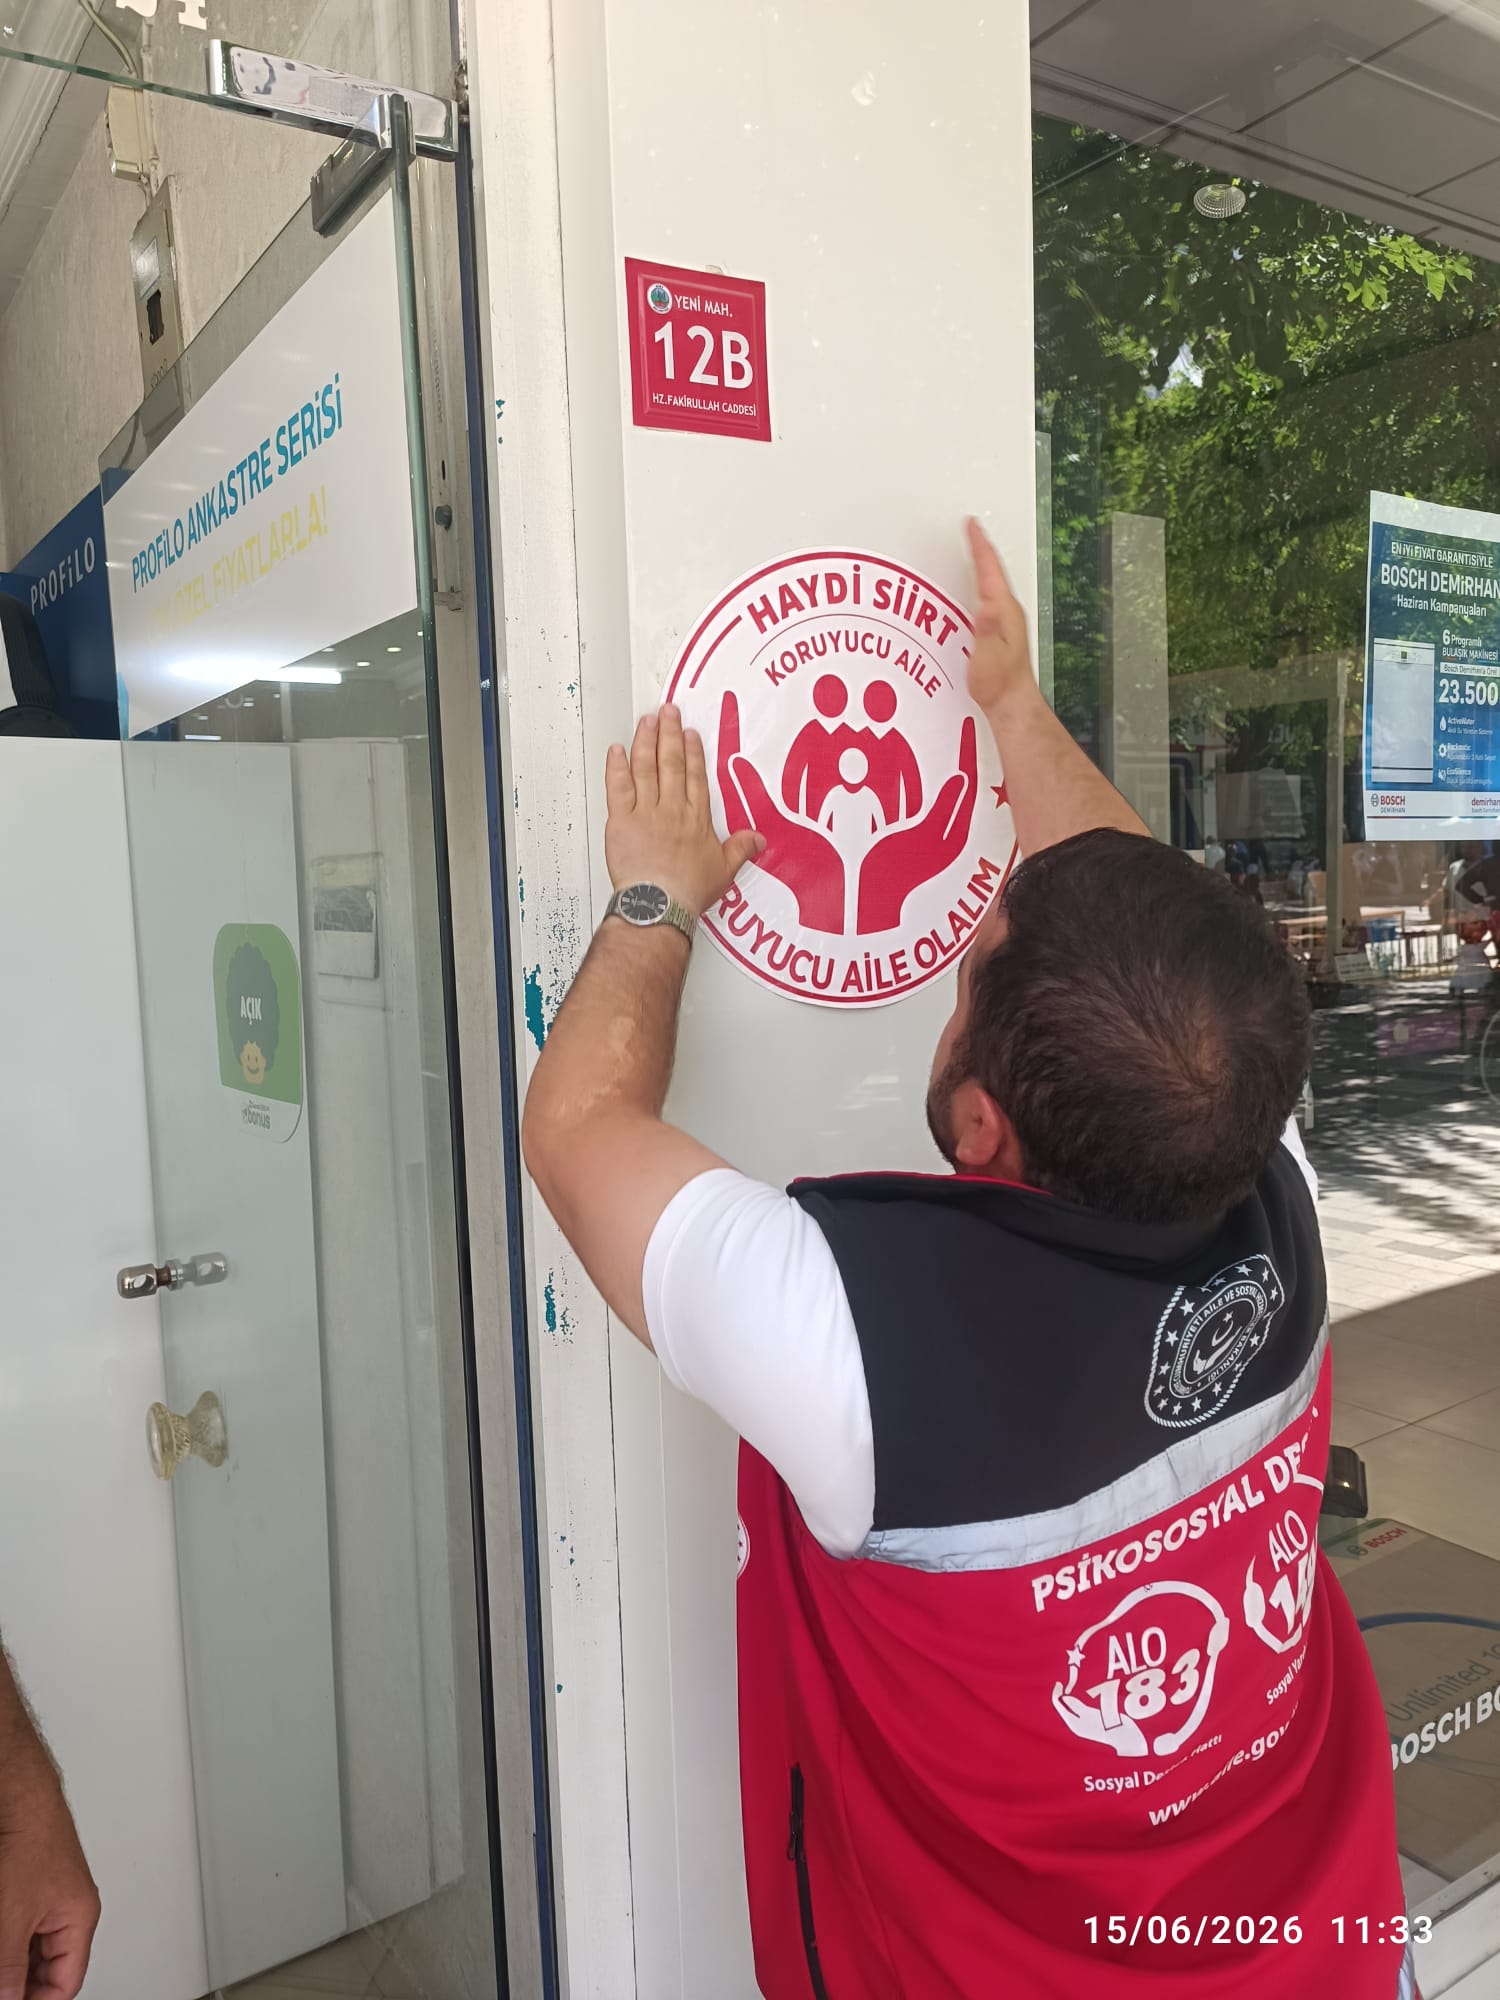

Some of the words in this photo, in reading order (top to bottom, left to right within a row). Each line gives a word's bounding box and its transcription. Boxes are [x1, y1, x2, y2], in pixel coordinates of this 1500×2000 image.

[674, 294, 701, 312] YENİ
[704, 301, 733, 318] MAH.
[654, 320, 754, 390] 12B
[652, 392, 720, 412] HZ.FAKİRULLAH
[722, 402, 757, 417] CADDESİ
[188, 438, 273, 551] ANKASTRE
[1381, 563, 1427, 591] BOSCH
[746, 564, 861, 635] HAYDİ
[872, 577, 959, 648] SİİRT
[1396, 594, 1429, 611] Haziran
[1430, 598, 1487, 618] Kampanyaları
[1442, 629, 1451, 646] 6
[763, 630, 892, 687] KORUYUCU
[894, 650, 942, 699] AİLE
[1438, 678, 1499, 706] 23.500
[1380, 795, 1406, 806] BOSCH
[717, 881, 836, 990] RUYUCU
[841, 948, 912, 994] AİLE
[913, 856, 1001, 969] OLALIM
[240, 996, 262, 1024] AÇIK
[1203, 1297, 1224, 1317] AİLE
[1224, 1290, 1235, 1302] VE
[1031, 1481, 1265, 1613] PSİKOSOSYAL
[1268, 1509, 1308, 1573] ALO
[1363, 1527, 1407, 1549] BOSCH
[1106, 1626, 1167, 1680] ALO
[1086, 1648, 1201, 1731] 183
[1265, 1665, 1295, 1706] Sosyal
[1387, 1659, 1494, 1722] Unlimited
[1083, 1771, 1140, 1794] Sosyal
